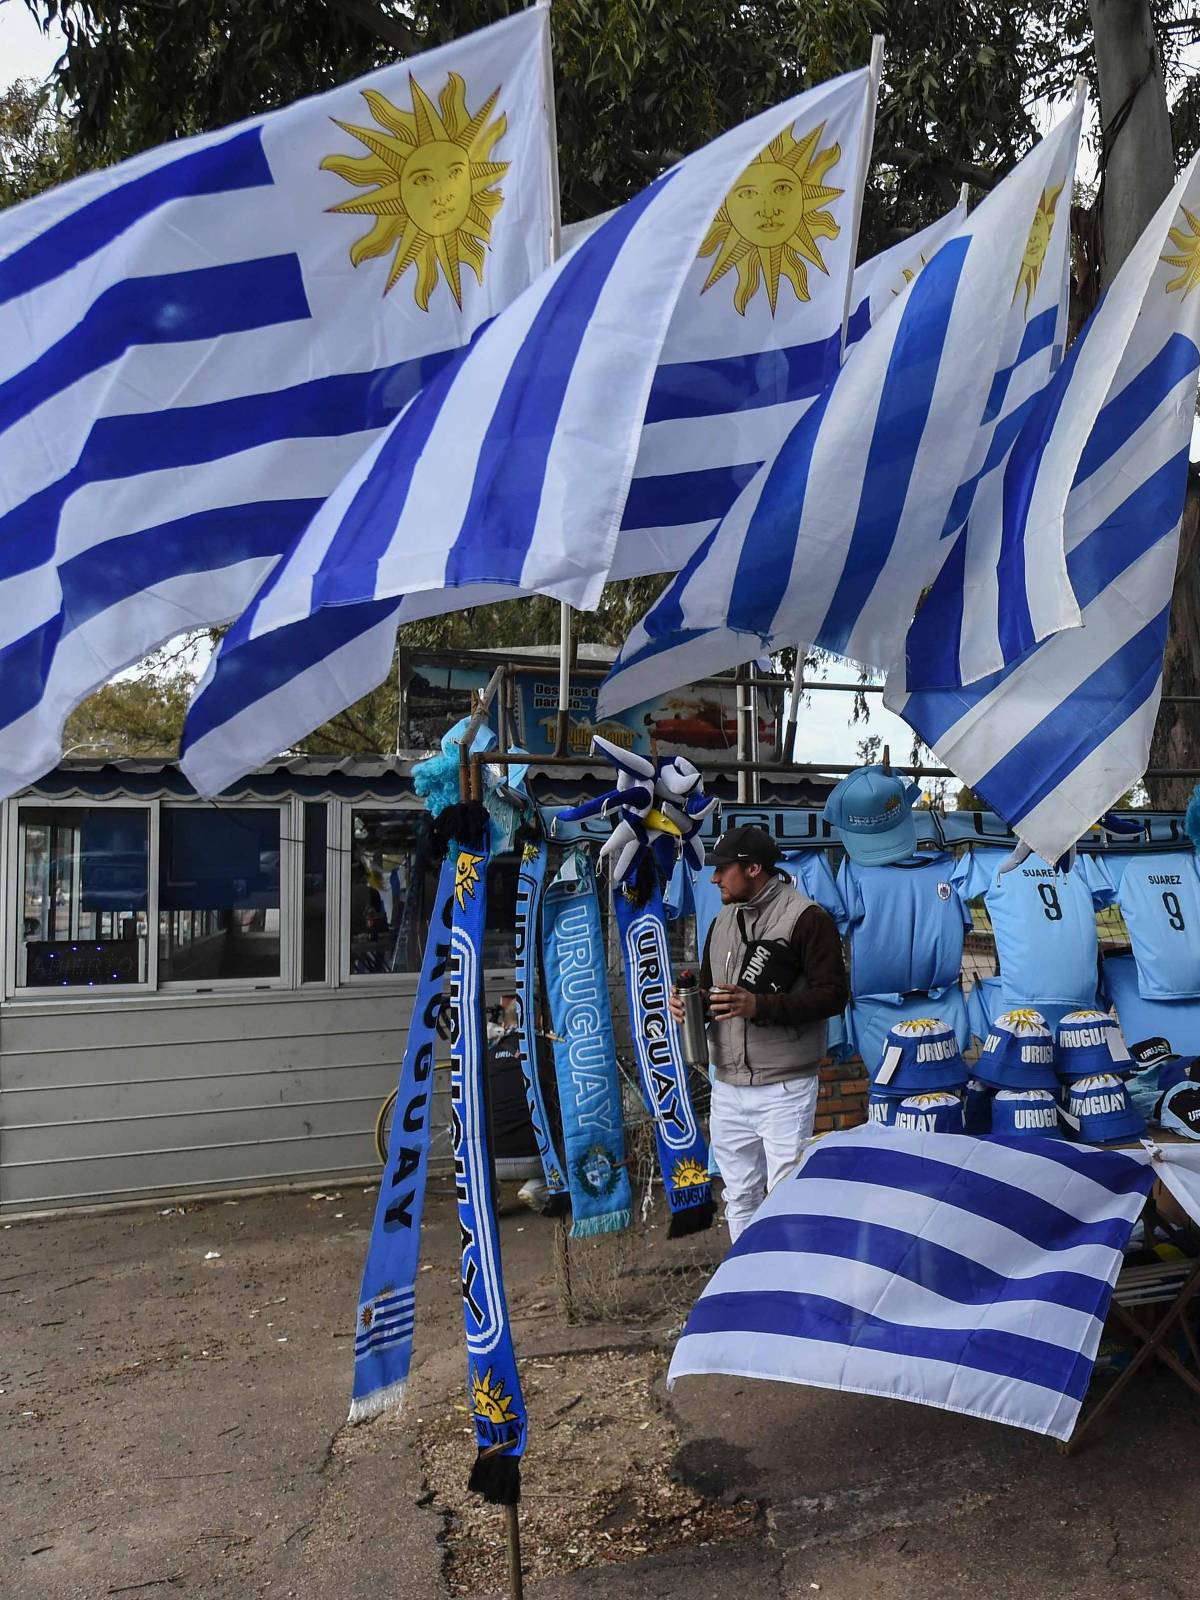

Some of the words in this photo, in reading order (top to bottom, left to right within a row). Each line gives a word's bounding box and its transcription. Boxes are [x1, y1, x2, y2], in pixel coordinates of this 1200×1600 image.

[535, 684, 588, 696] Desues
[535, 698, 590, 709] paro...
[1148, 875, 1182, 885] SUAREZ
[1038, 883, 1063, 921] 9
[1162, 891, 1186, 931] 9
[742, 944, 771, 985] PUMA
[554, 905, 613, 1133] URUGUAY
[635, 930, 687, 1133] URUGUAY
[494, 1051, 514, 1059] URU
[1069, 1092, 1126, 1117] URUGUAY
